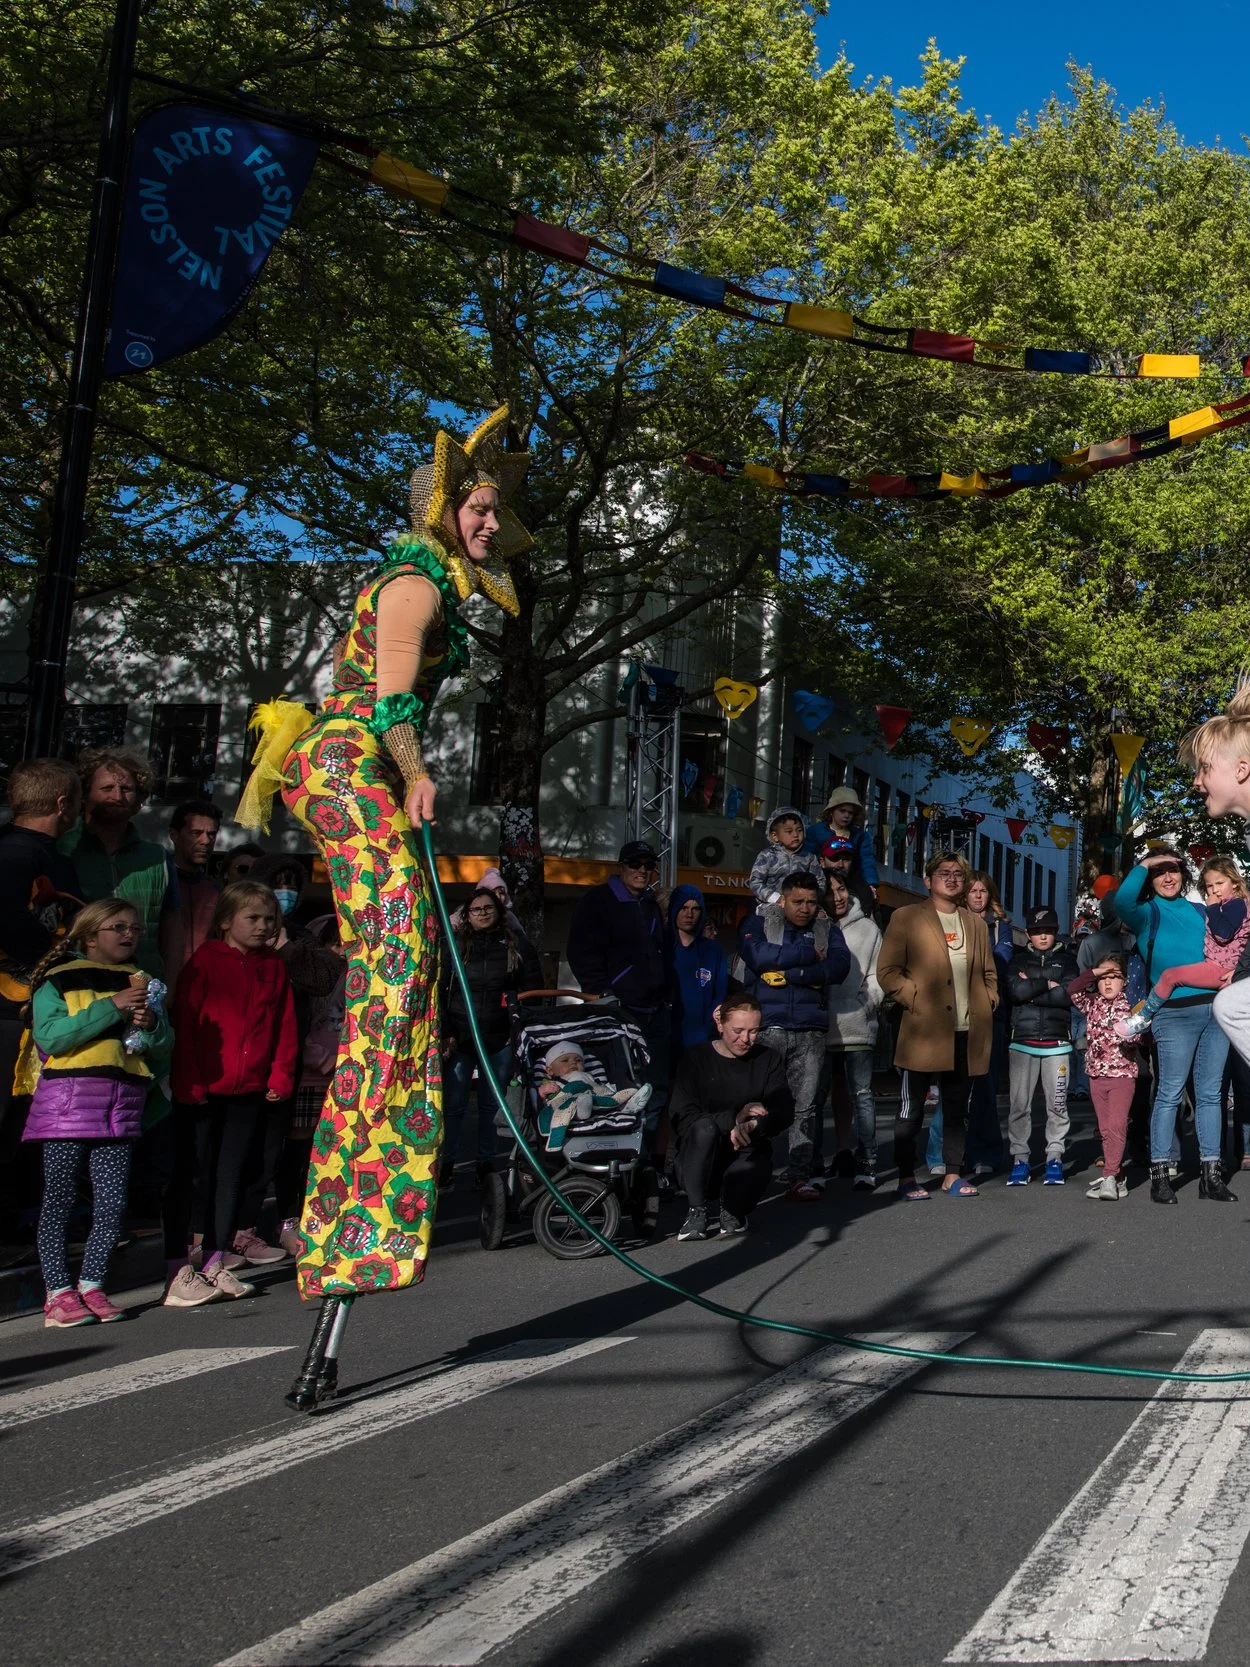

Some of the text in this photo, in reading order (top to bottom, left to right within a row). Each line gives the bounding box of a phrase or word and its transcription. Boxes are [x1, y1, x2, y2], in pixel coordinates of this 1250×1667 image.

[139, 126, 292, 291] NELSON ARTS FESTIVAL
[1054, 1075, 1067, 1114] LAKERS
